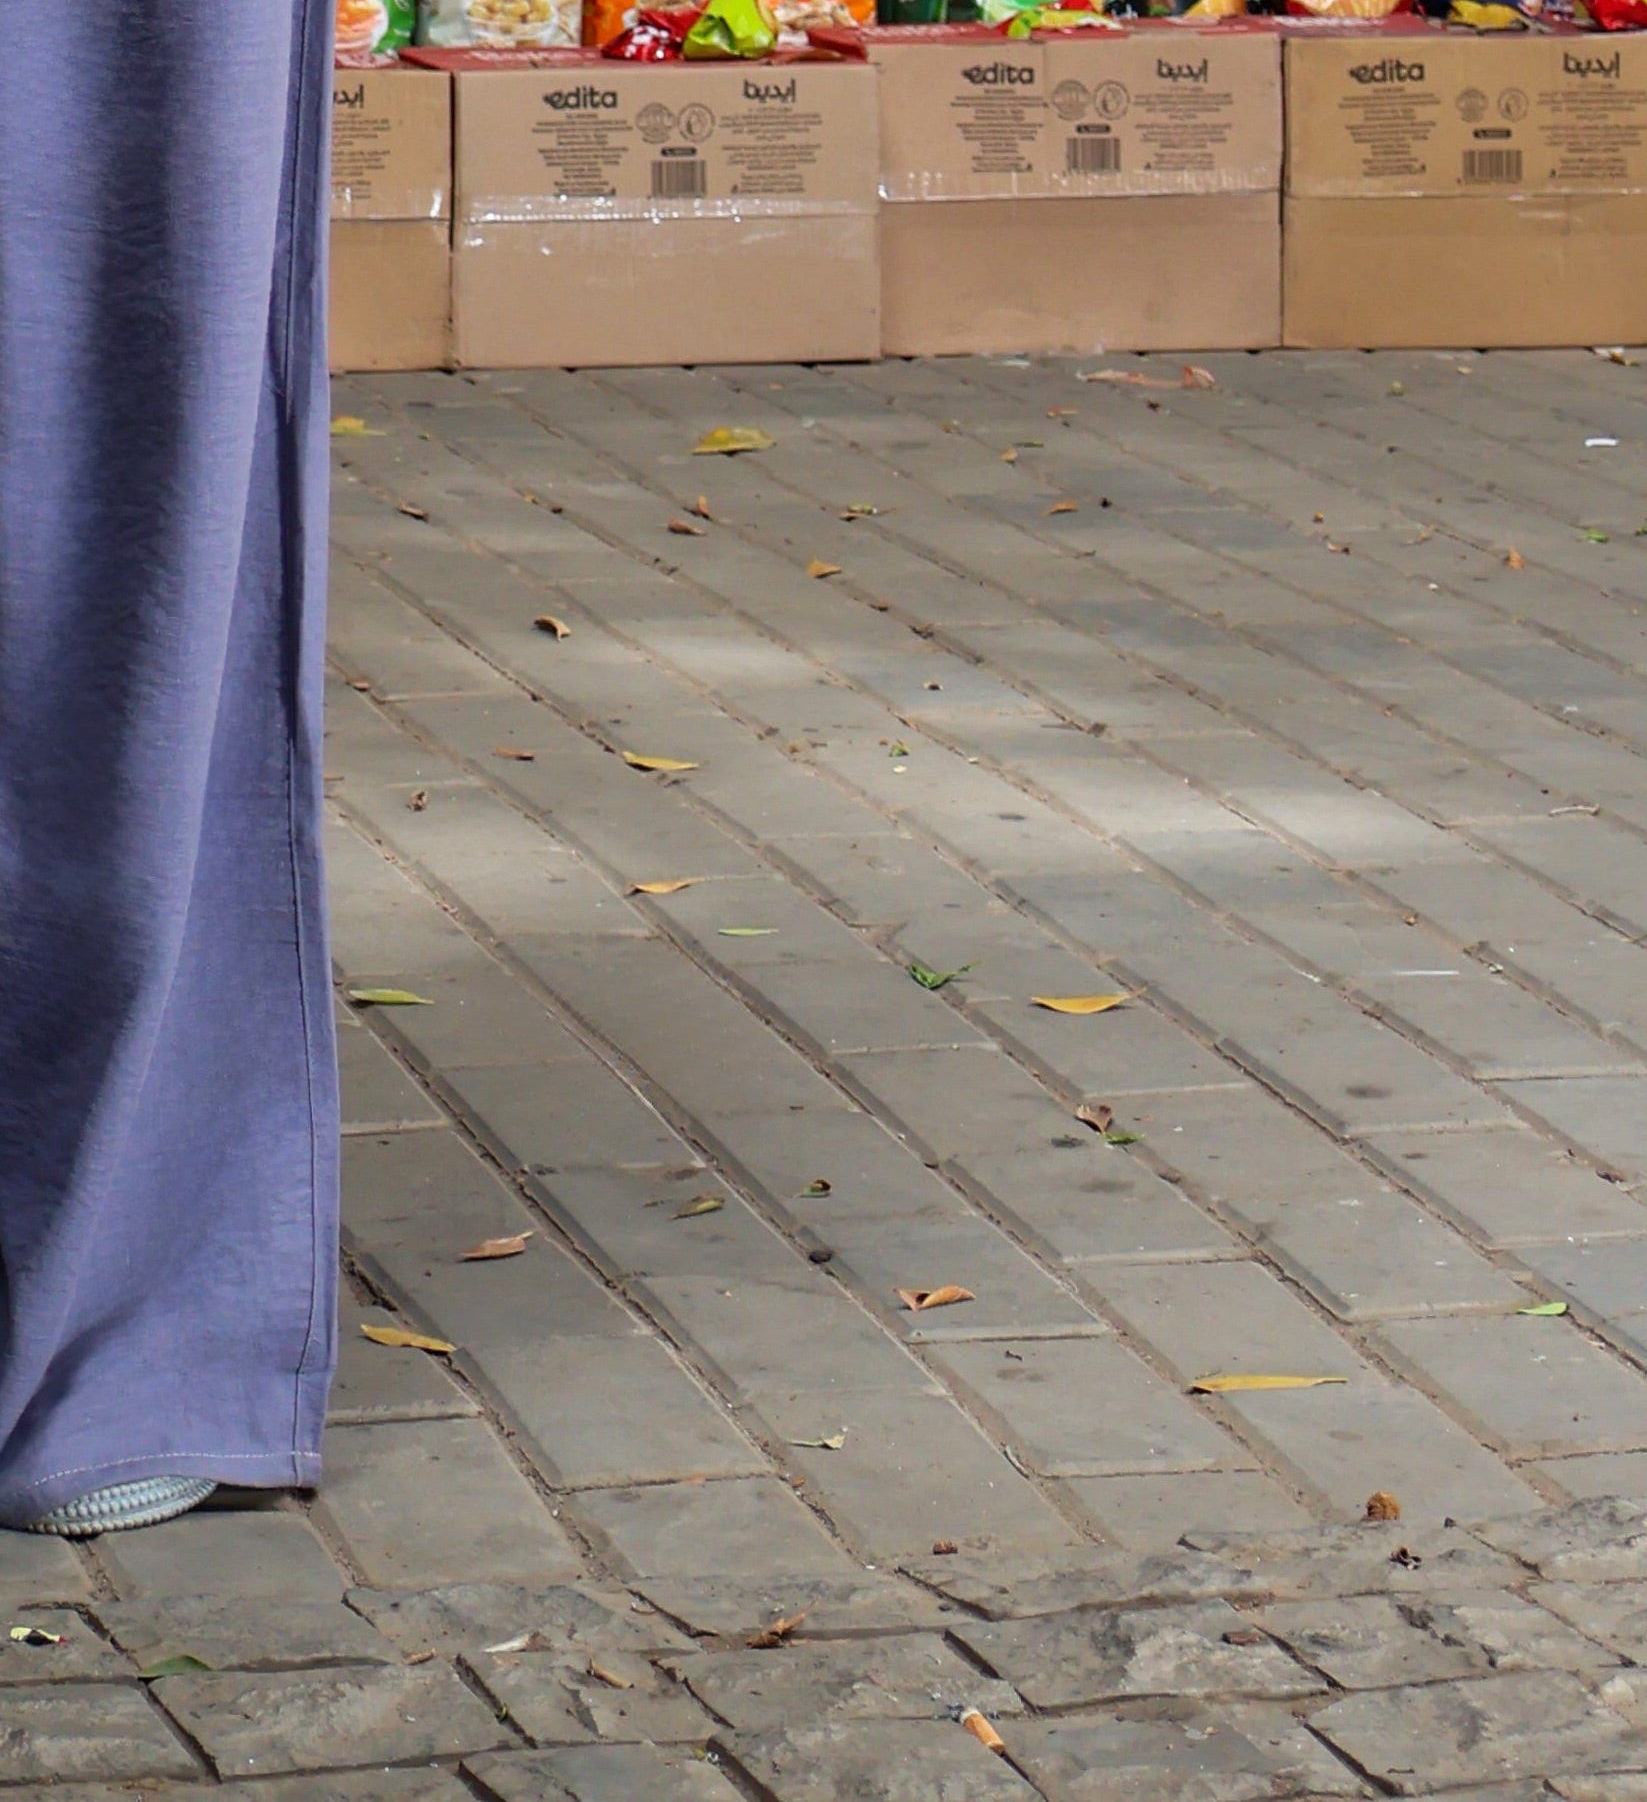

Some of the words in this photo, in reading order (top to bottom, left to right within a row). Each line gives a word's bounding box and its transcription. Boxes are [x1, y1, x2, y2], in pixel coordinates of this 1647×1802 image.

[962, 60, 1035, 87] edita
[1349, 57, 1424, 85] edita
[543, 87, 617, 112] edita
